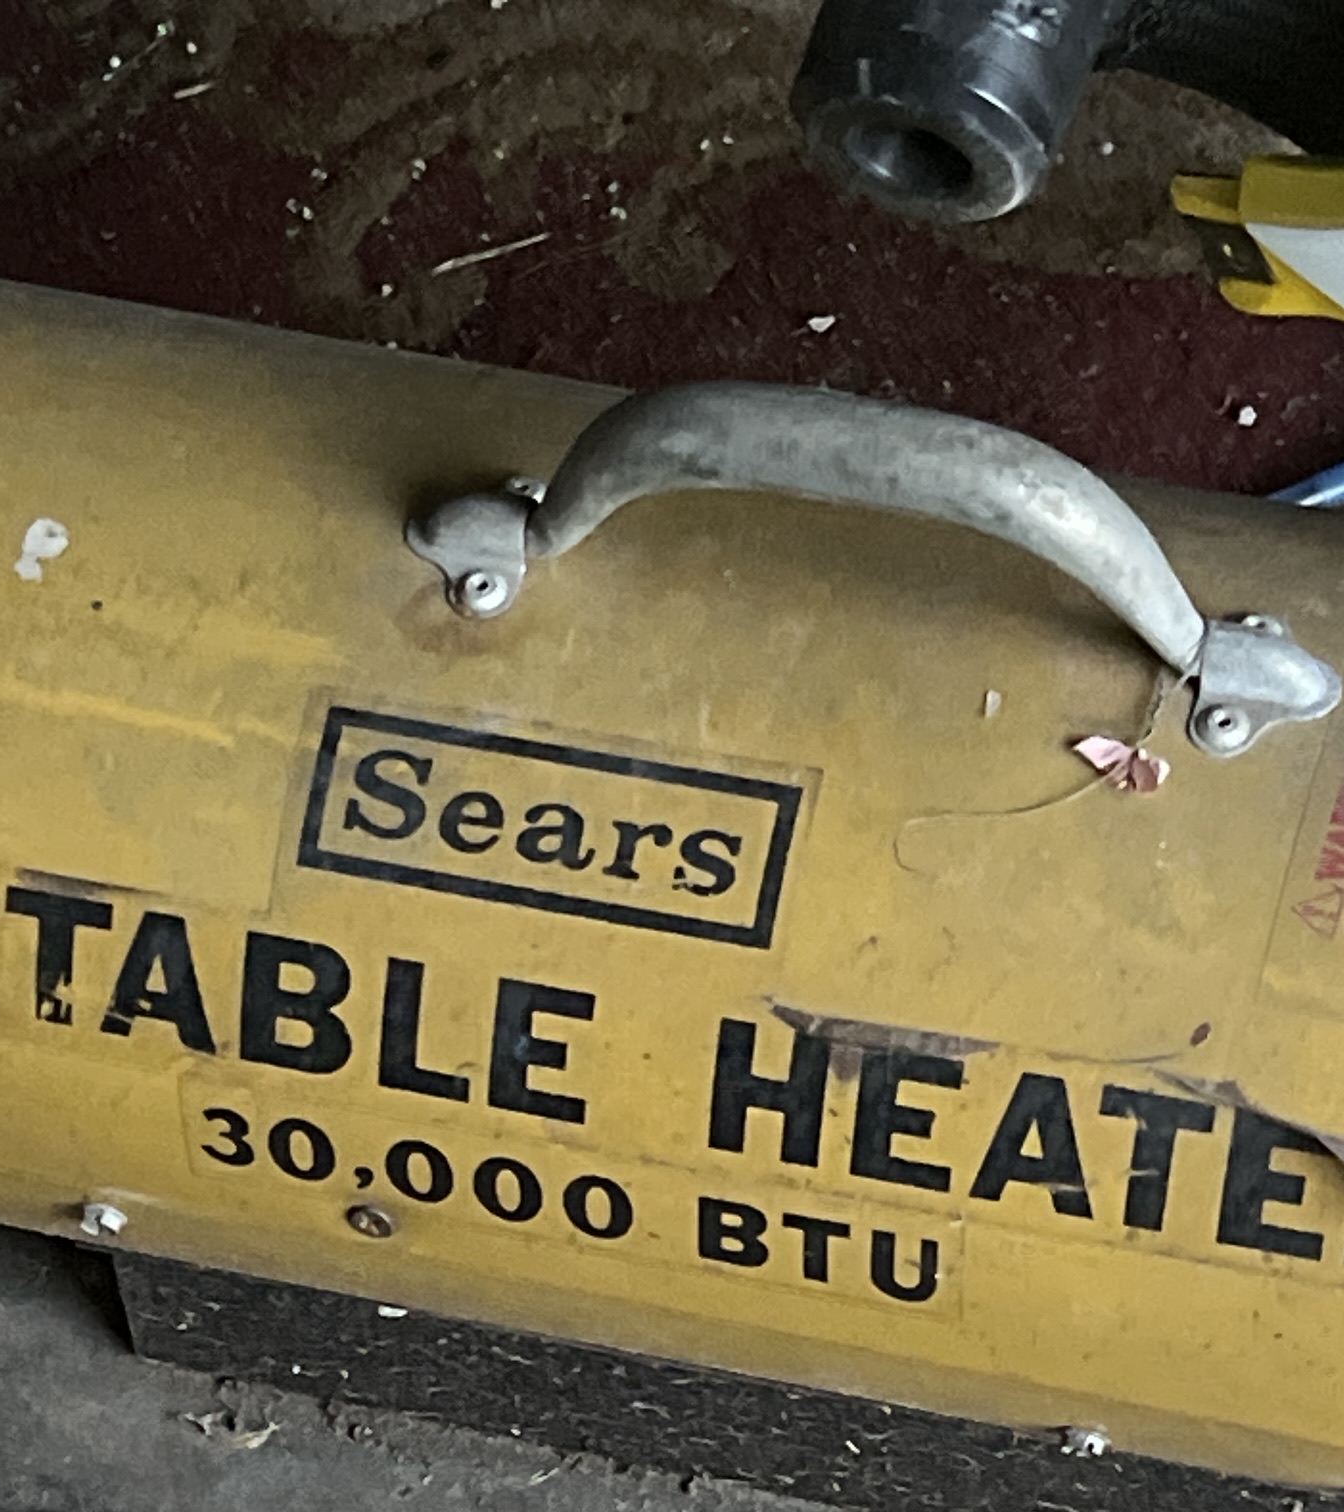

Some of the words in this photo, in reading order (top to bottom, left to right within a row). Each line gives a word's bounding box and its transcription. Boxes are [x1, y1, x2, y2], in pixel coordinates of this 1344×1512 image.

[343, 749, 744, 897] Sears
[201, 1107, 633, 1240] 30,000
[697, 1196, 939, 1302] BTU
